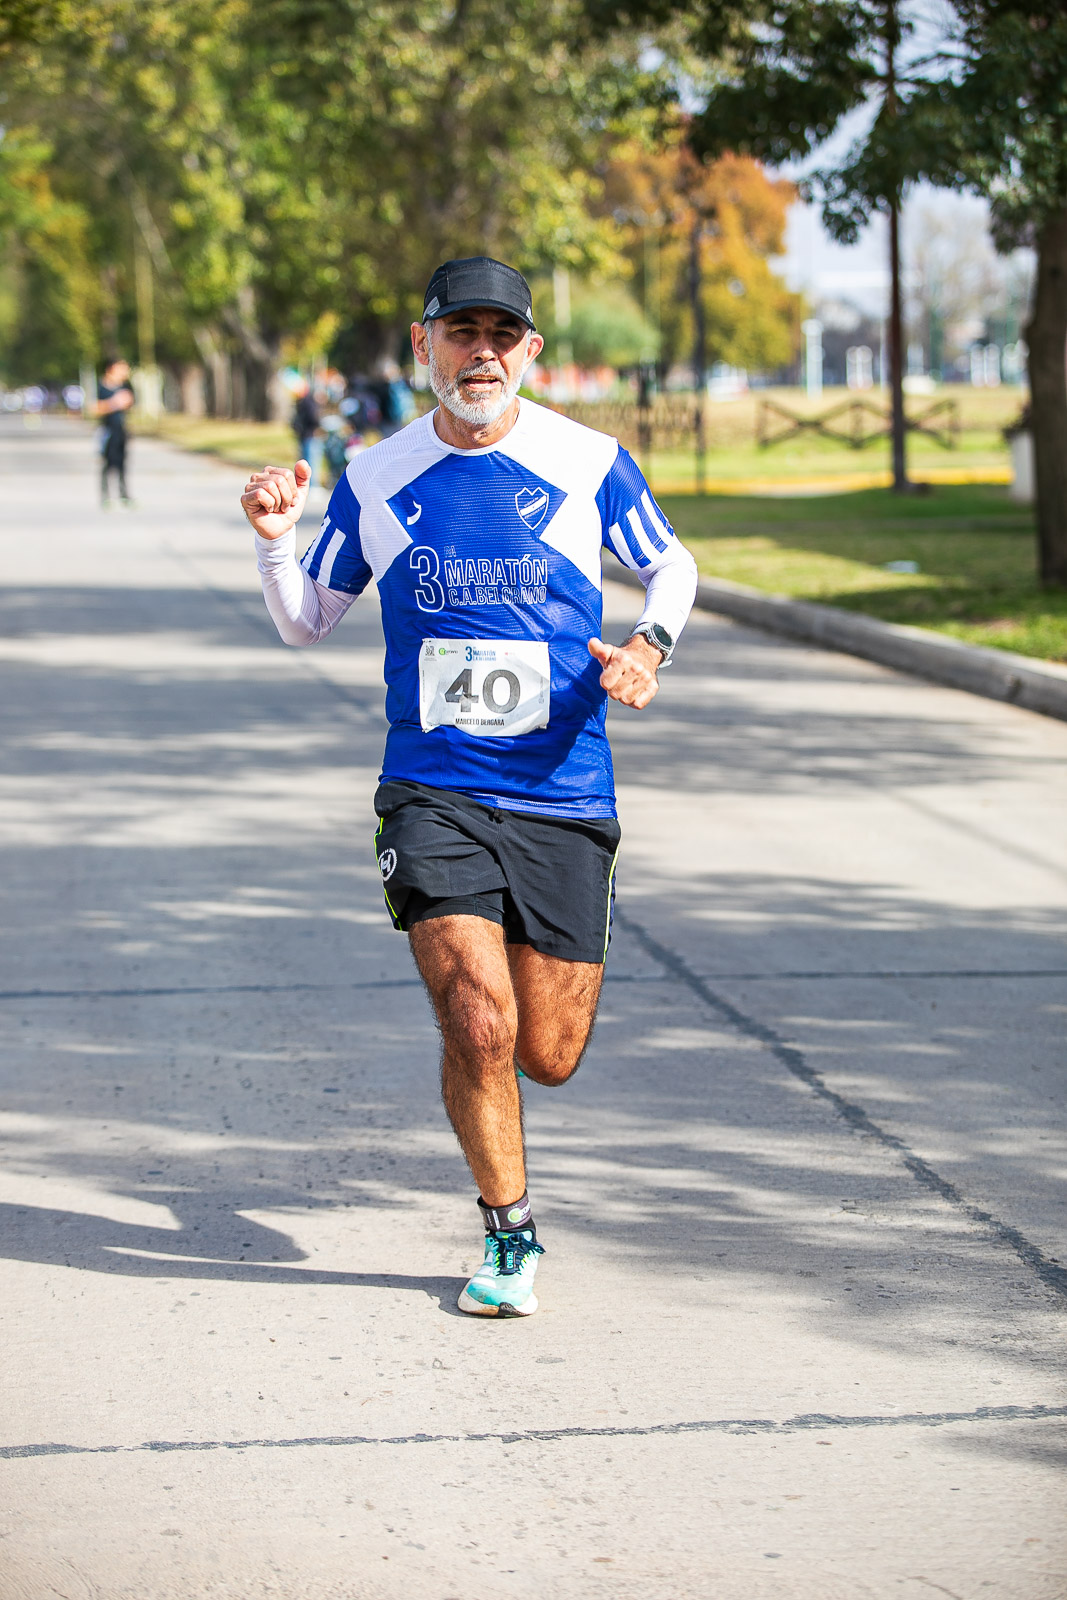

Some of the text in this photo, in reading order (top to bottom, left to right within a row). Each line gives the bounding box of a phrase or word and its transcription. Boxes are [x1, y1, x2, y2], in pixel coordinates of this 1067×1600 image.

[409, 545, 445, 613] 3
[444, 554, 548, 587] MARATÓN
[465, 645, 473, 662] 3
[444, 668, 521, 714] 40
